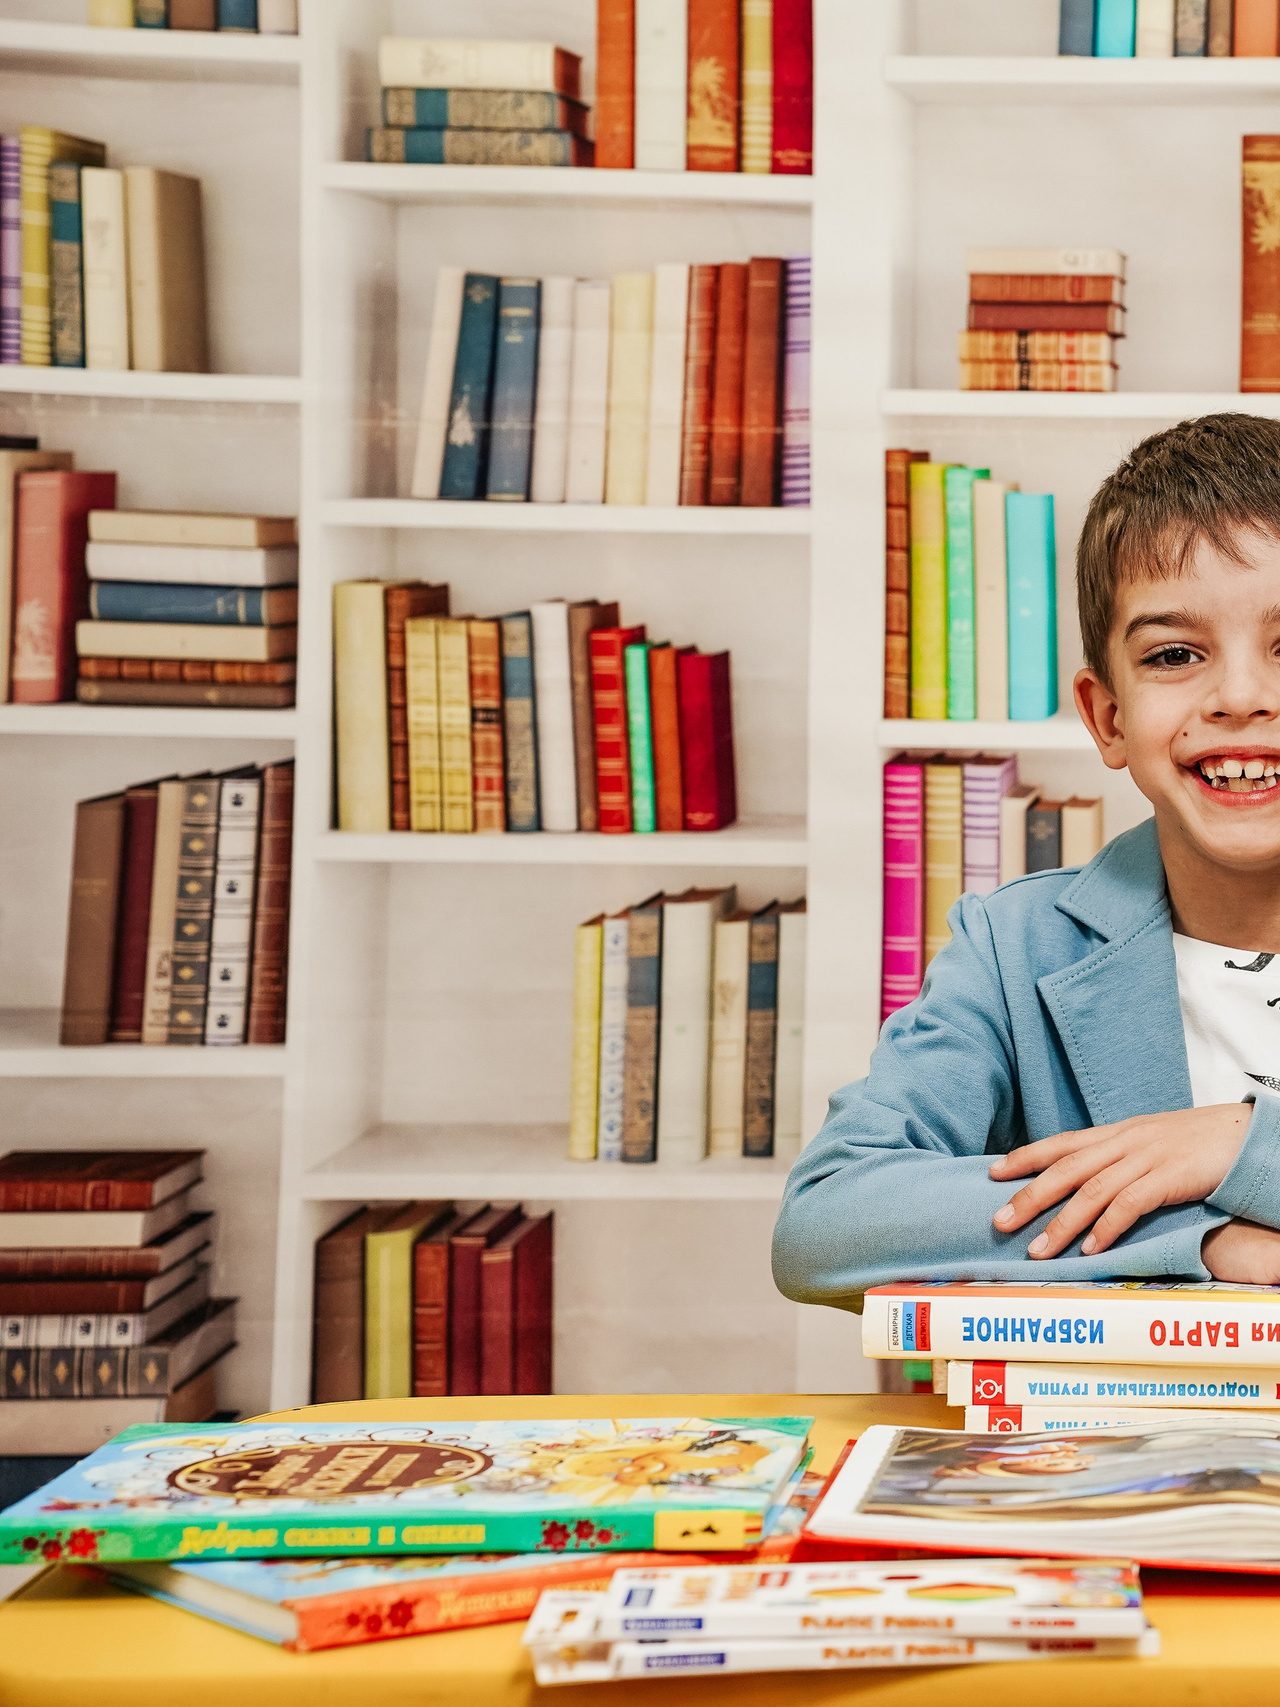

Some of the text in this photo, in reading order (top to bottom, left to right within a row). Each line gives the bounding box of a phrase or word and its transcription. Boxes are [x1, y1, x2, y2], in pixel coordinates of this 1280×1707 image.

[892, 1307, 900, 1346] ВСЕМИРНАЯ
[905, 1312, 914, 1342] ДЕТСКАЯ
[920, 1306, 928, 1348] БИБЛИОТЕКА
[962, 1316, 1104, 1345] ИЗБРАННОЕ
[1149, 1319, 1240, 1349] БАРТО
[1028, 1382, 1089, 1396] ГРУППА
[1096, 1382, 1261, 1399] ПОДГОТОВИТЕЛЬНАЯ
